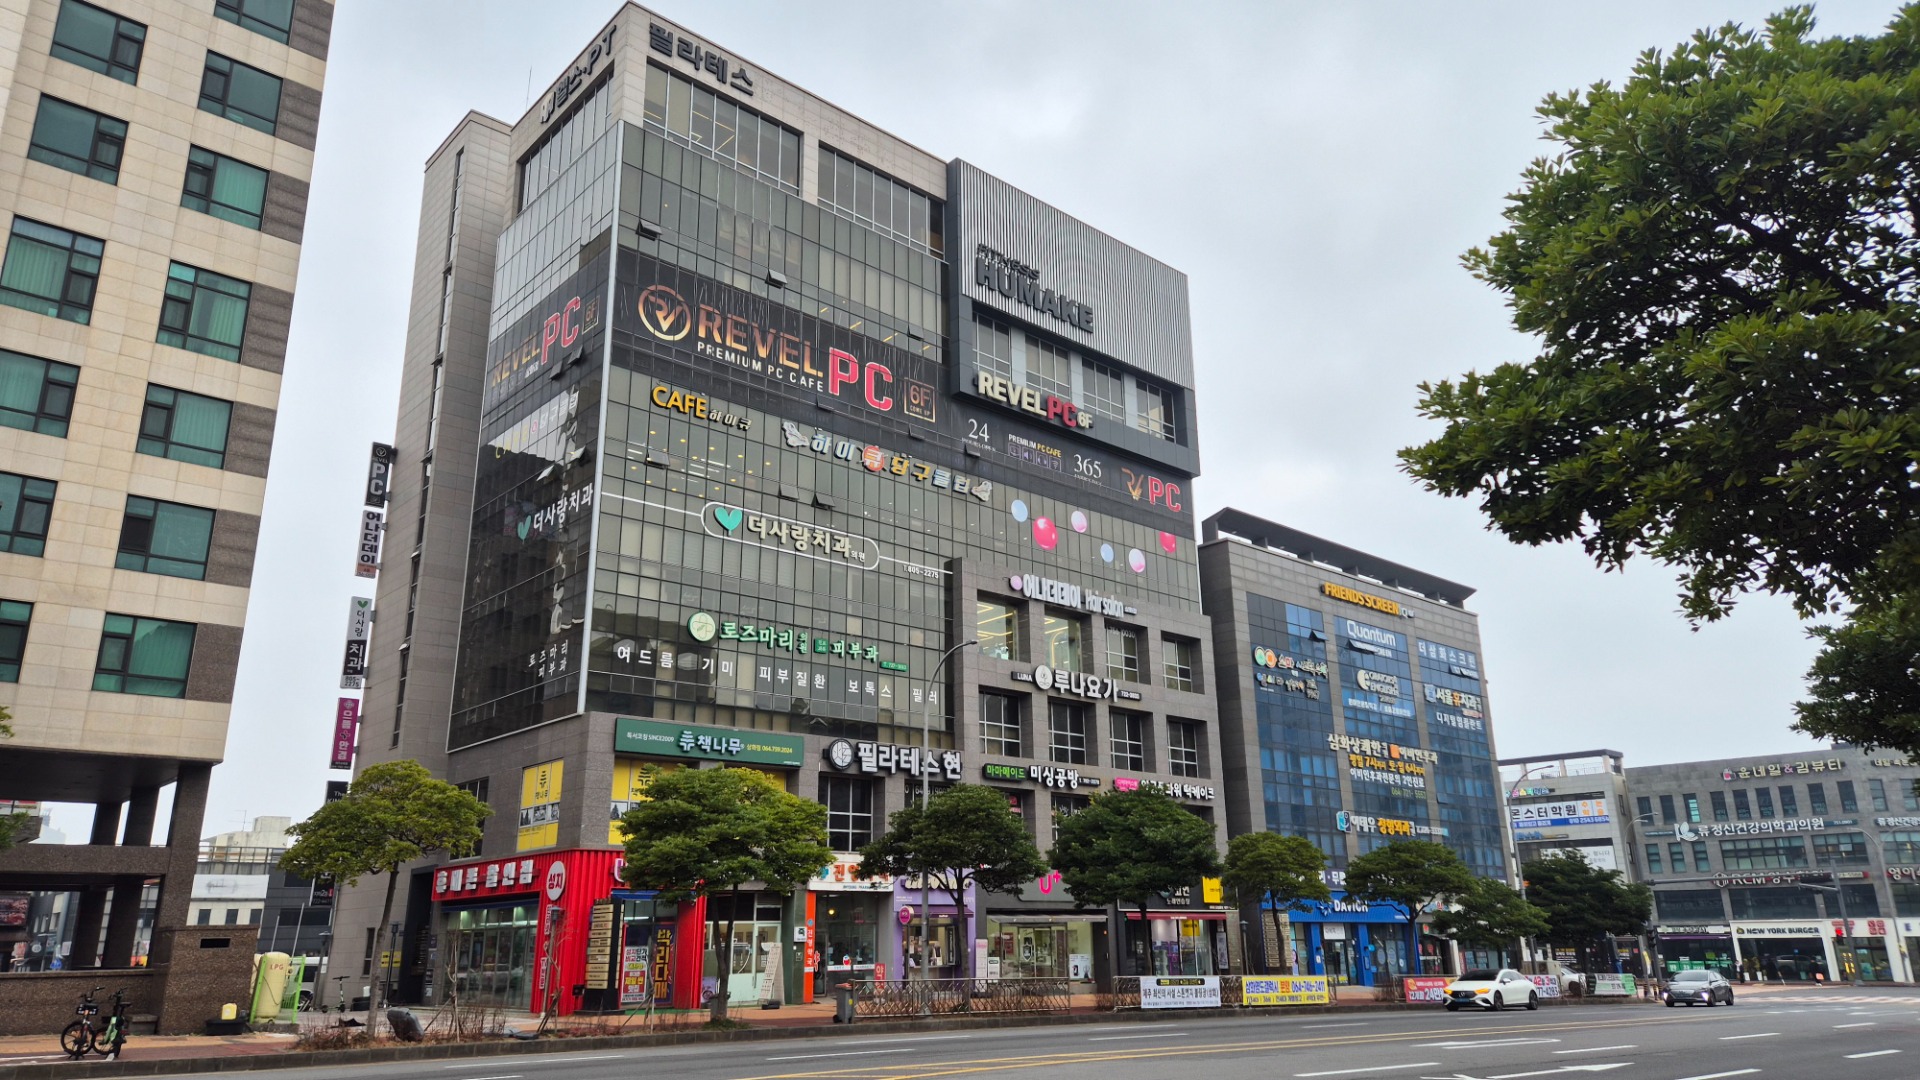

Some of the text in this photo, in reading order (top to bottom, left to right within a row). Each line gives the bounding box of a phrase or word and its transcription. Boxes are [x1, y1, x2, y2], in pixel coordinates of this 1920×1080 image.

[649, 22, 754, 96] 필라테스
[976, 258, 1093, 333] HUMAKE
[540, 295, 581, 366] PC
[697, 341, 824, 394] PREMIUM PC CAFE
[698, 303, 893, 412] REVEL PC
[652, 385, 752, 431] CAFE 하이큐
[910, 384, 931, 407] 6F
[976, 370, 1093, 429] REVEL PC 6F
[967, 417, 990, 443] 24
[1008, 433, 1062, 458] PREMIUM PC CAFE
[369, 462, 386, 497] PC
[890, 454, 972, 495] 당구클럽
[1073, 453, 1102, 479] 365
[533, 482, 594, 532] 더사랑치과
[1148, 475, 1182, 513] PC
[360, 511, 381, 565] 어나더데이
[747, 514, 852, 559] 더사랑치과
[1022, 573, 1081, 610] 어나더데이
[1324, 581, 1399, 615] FRIENDS SCREEN
[354, 609, 366, 638] 더사랑
[719, 621, 794, 651] 로즈마리
[1346, 619, 1397, 647] Quantum
[348, 642, 365, 672] 치과
[528, 639, 569, 668] 로즈마리
[831, 640, 879, 662] 피부과
[616, 645, 938, 705] 여드름 기미 피부질환 보톡스 필러
[1016, 671, 1033, 683] LUNA
[1054, 668, 1119, 702] 루나요가
[697, 733, 742, 756] 책나무
[1399, 746, 1438, 765] 이비인후과
[857, 742, 962, 780] 필라테스 현
[1349, 753, 1364, 768] 평일
[986, 764, 1079, 790] 마마메이드 미싱공방
[1183, 783, 1215, 800] 떡케이크
[1349, 767, 1402, 786] 이비인후과전문의
[1697, 817, 1825, 838] 류정신건강의학과의원
[435, 867, 478, 894] 휴대폰
[1746, 926, 1820, 935] NEW YORK BURGER
[269, 963, 284, 971] LPG
[654, 928, 672, 999] 박리다매
